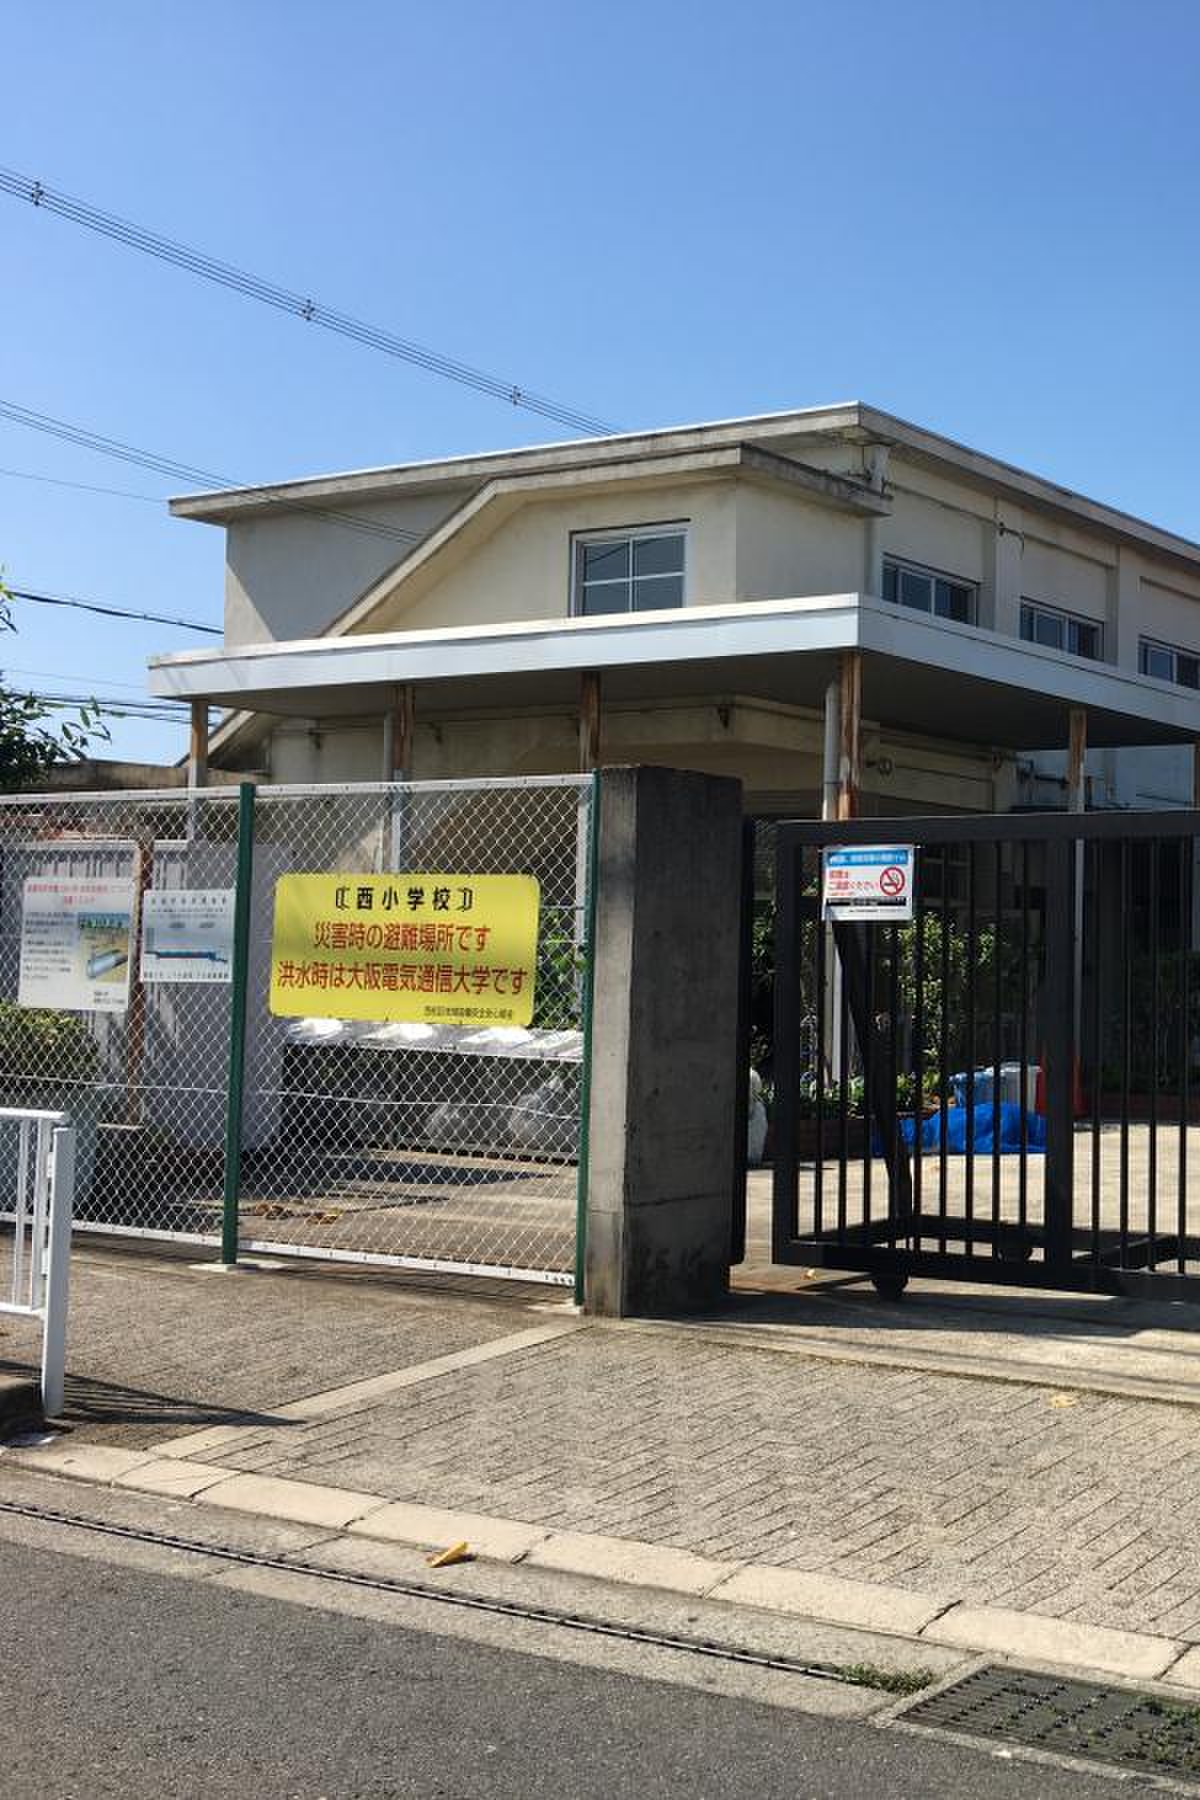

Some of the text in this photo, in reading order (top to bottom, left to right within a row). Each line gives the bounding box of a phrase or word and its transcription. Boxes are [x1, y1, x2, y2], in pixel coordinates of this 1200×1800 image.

[313, 921, 491, 952] 災害時の避難場所です
[277, 960, 528, 996] 洪水時は大阪電気通信大学です
